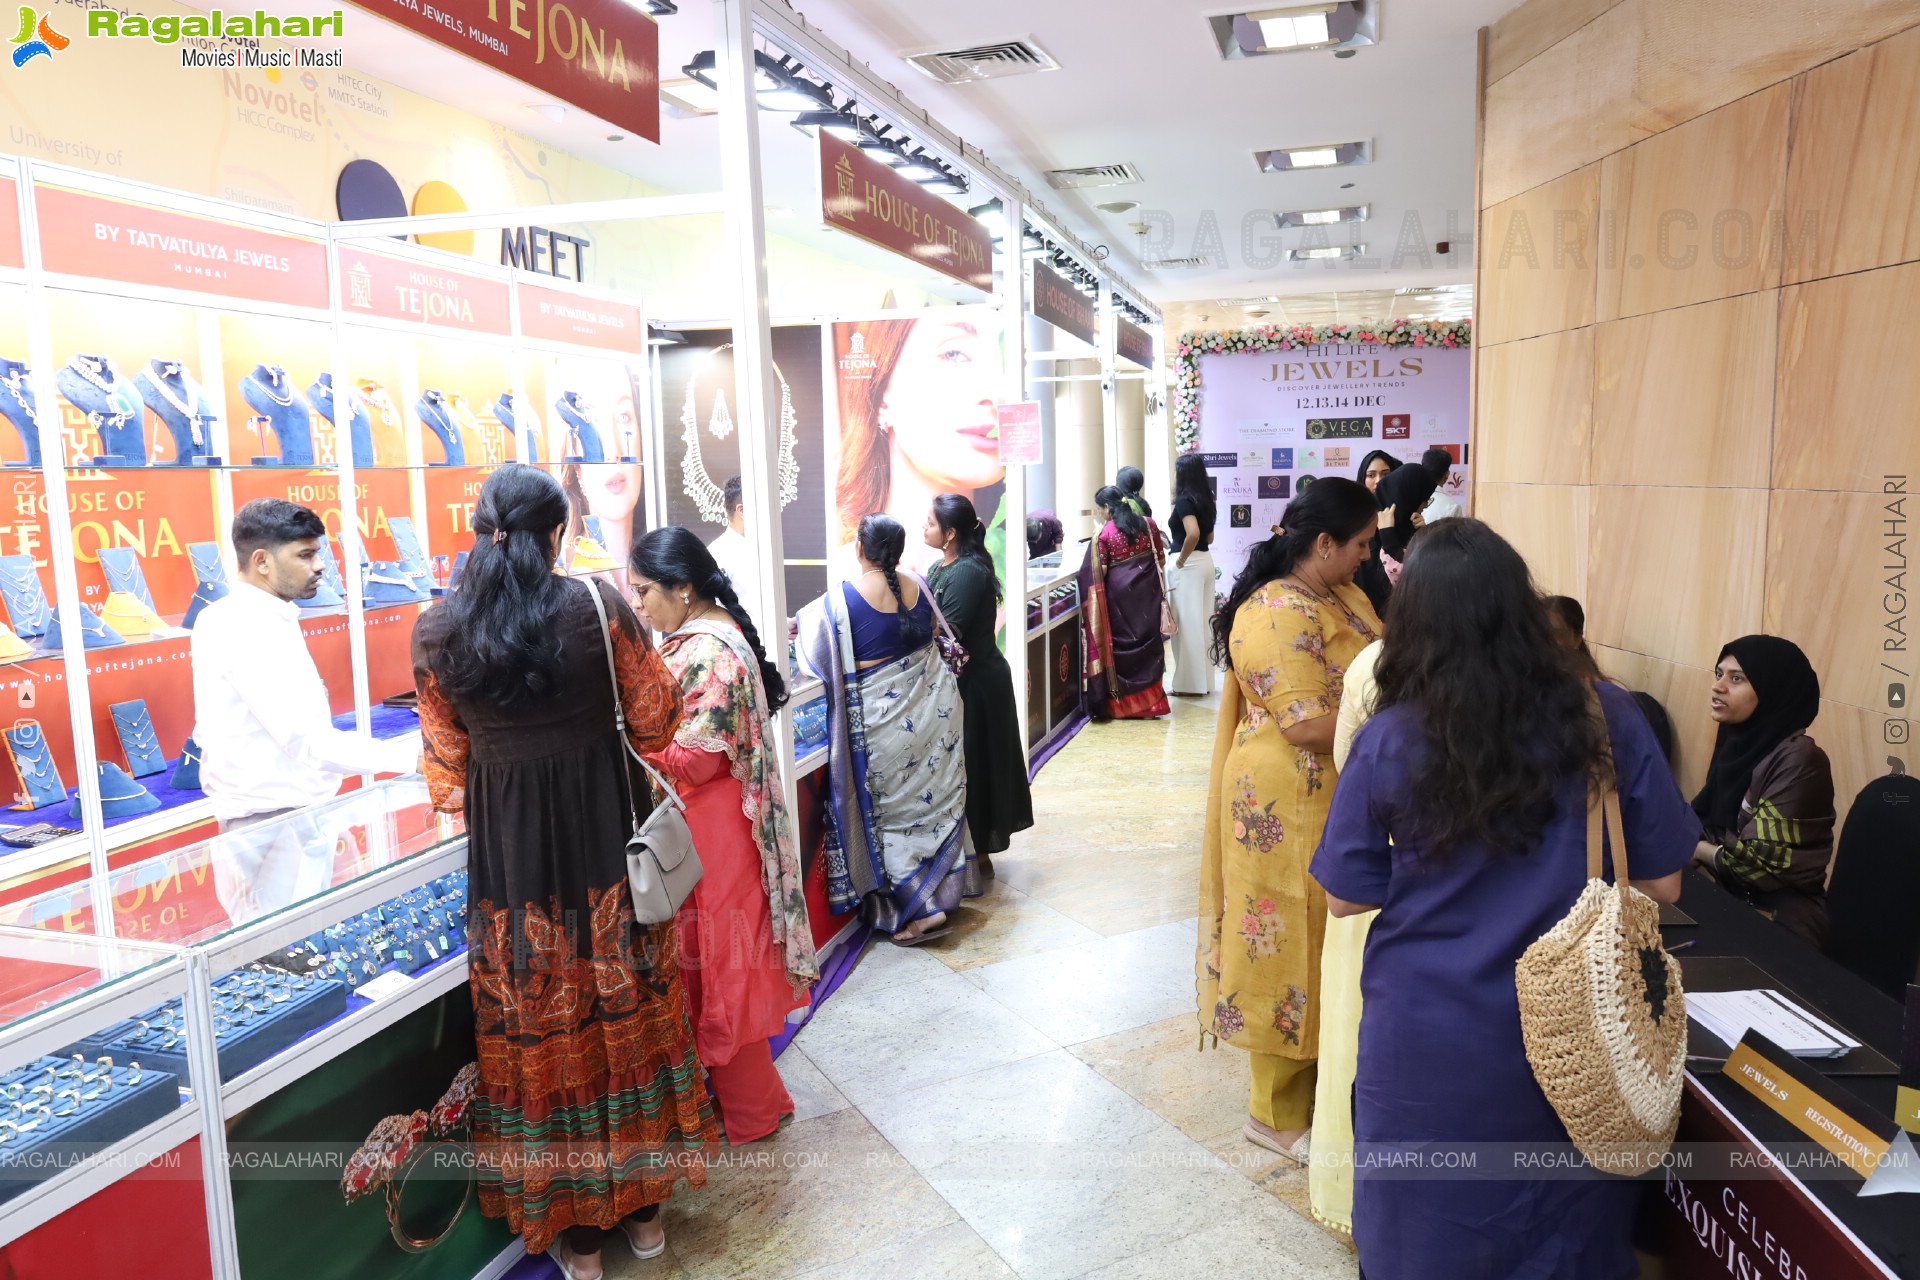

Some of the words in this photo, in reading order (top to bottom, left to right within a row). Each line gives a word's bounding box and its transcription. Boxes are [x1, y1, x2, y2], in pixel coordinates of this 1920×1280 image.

[421, 3, 466, 37] JEWELS,
[469, 26, 508, 56] MUMBAI
[222, 68, 322, 126] Novotel
[337, 73, 363, 92] HITEC
[365, 83, 382, 101] City
[328, 87, 355, 107] MMTS
[358, 97, 388, 118] Station
[238, 106, 266, 129] HICC
[267, 116, 316, 143] Complex
[9, 125, 101, 166] University
[106, 149, 123, 166] of
[865, 180, 920, 238] HOUSE
[923, 213, 940, 246] OF
[945, 224, 985, 270] TEJONA
[94, 223, 120, 243] BY
[126, 228, 229, 261] TATVATULYA
[233, 249, 290, 273] JEWELS
[501, 226, 590, 283] MEET
[174, 263, 228, 280] MUMBAI
[409, 271, 445, 290] HOUSE
[446, 278, 460, 292] OF
[395, 286, 474, 323] TEJONA
[1336, 343, 1379, 356] LIFE
[839, 359, 877, 370] TEJONA
[1262, 357, 1423, 382] JEWELS
[1277, 384, 1320, 392] DISCOVER
[1296, 397, 1349, 409] 12.13.14
[1354, 395, 1386, 407] DEC
[1329, 420, 1372, 432] VEGA
[115, 490, 146, 511] OF
[287, 485, 337, 502] HOUS
[85, 585, 101, 596] BY
[1739, 1063, 1789, 1101] JEWELS
[1805, 1107, 1872, 1158] REGISTRATION
